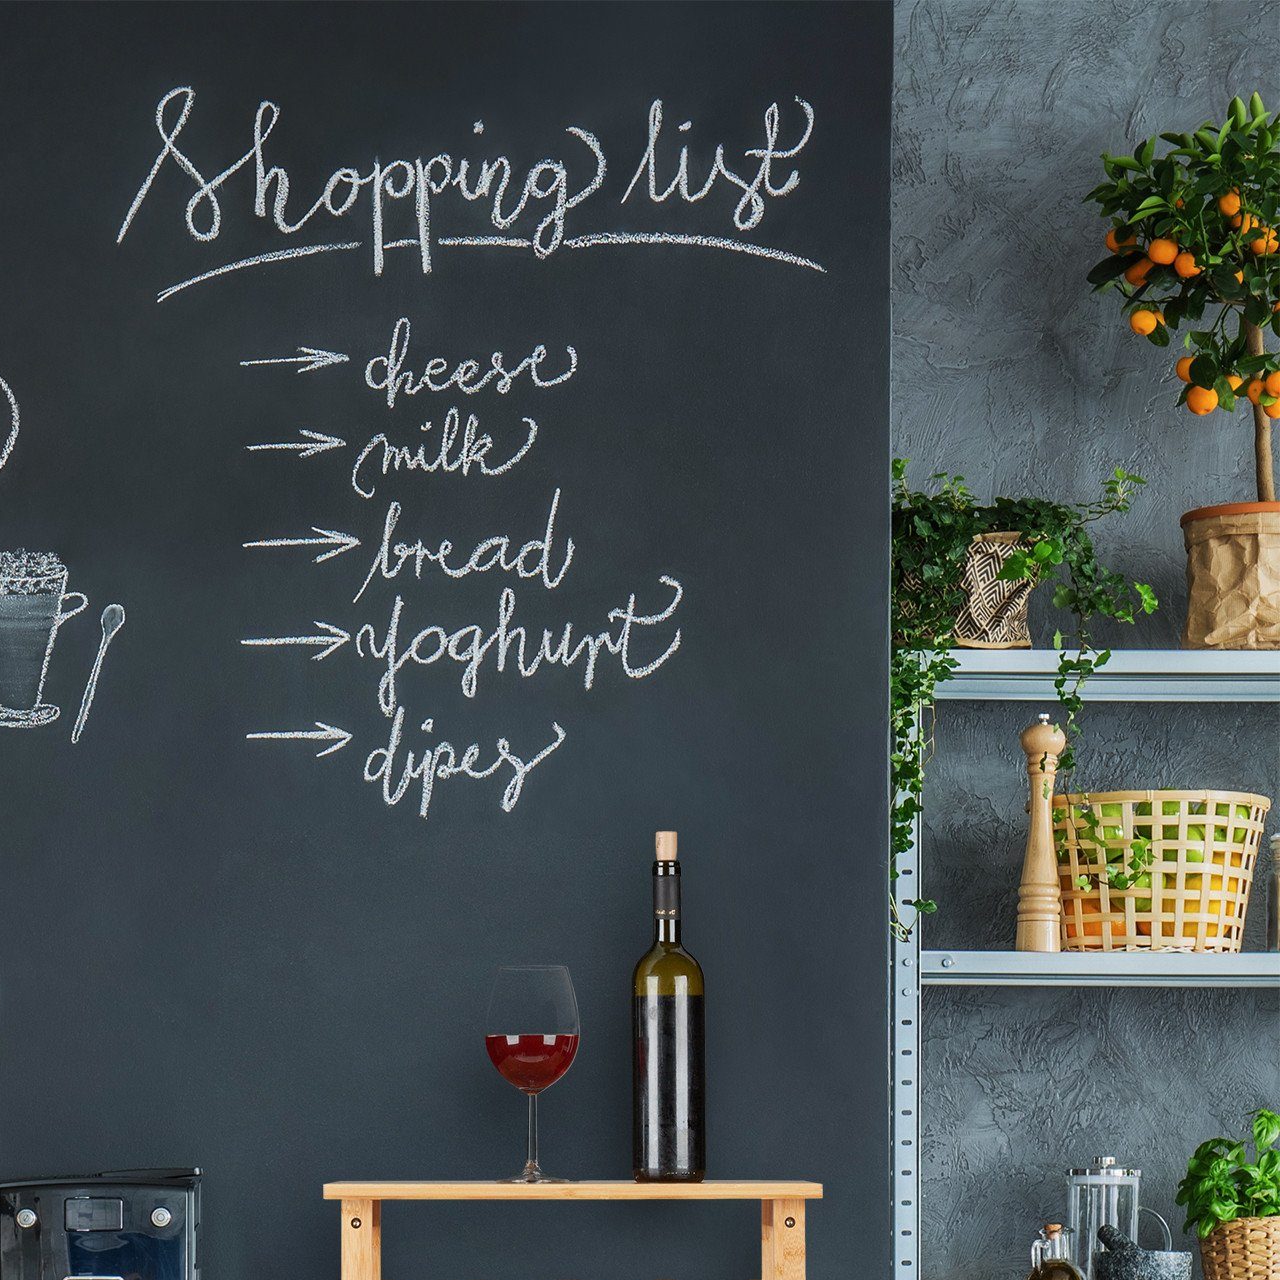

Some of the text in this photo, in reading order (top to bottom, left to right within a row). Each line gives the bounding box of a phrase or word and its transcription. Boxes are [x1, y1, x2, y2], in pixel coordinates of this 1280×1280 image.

[117, 87, 815, 275] Shopping list
[365, 317, 577, 408] cheese
[352, 406, 538, 498] milk
[353, 488, 575, 603] bread
